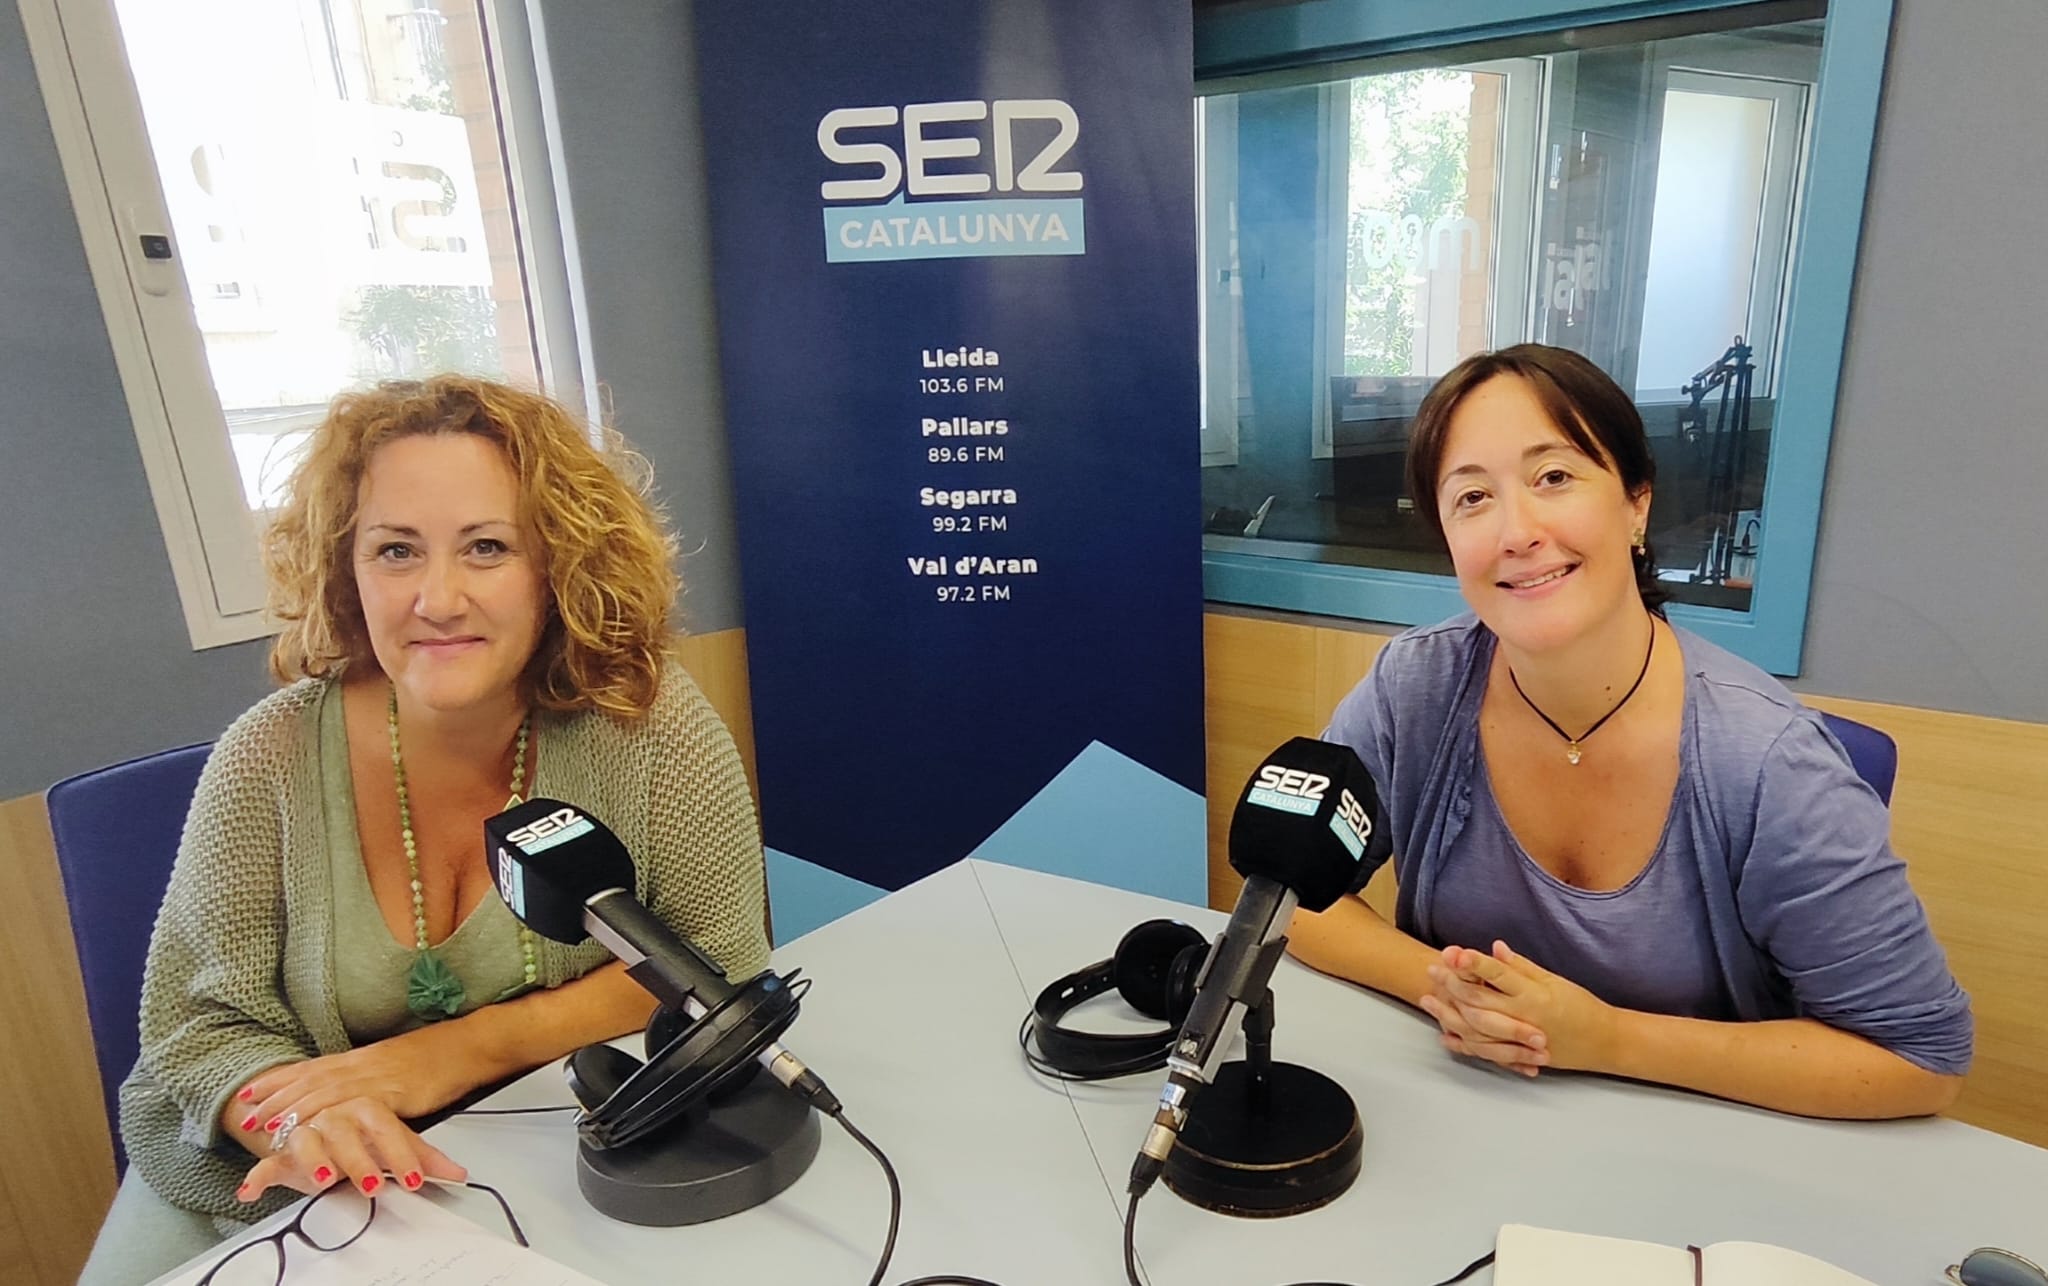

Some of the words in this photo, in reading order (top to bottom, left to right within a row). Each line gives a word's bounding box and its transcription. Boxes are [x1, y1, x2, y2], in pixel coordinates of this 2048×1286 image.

[817, 99, 1083, 200] SER
[840, 213, 1070, 249] CATALUNYA
[922, 347, 1000, 368] Lleida
[920, 378, 968, 394] 103.6
[975, 377, 1005, 393] FM
[922, 417, 1009, 437] Pallars
[928, 447, 969, 463] 89.6
[976, 446, 1005, 462] FM
[920, 487, 1017, 509] Segarra
[932, 517, 972, 532] 99.2
[979, 516, 1007, 531] FM
[907, 557, 948, 576] Val
[936, 586, 976, 602] 97.2
[982, 586, 1011, 601] FM
[1254, 765, 1331, 800] SER
[507, 808, 583, 846] SER
[1336, 788, 1372, 846] SER
[499, 848, 515, 910] SER
